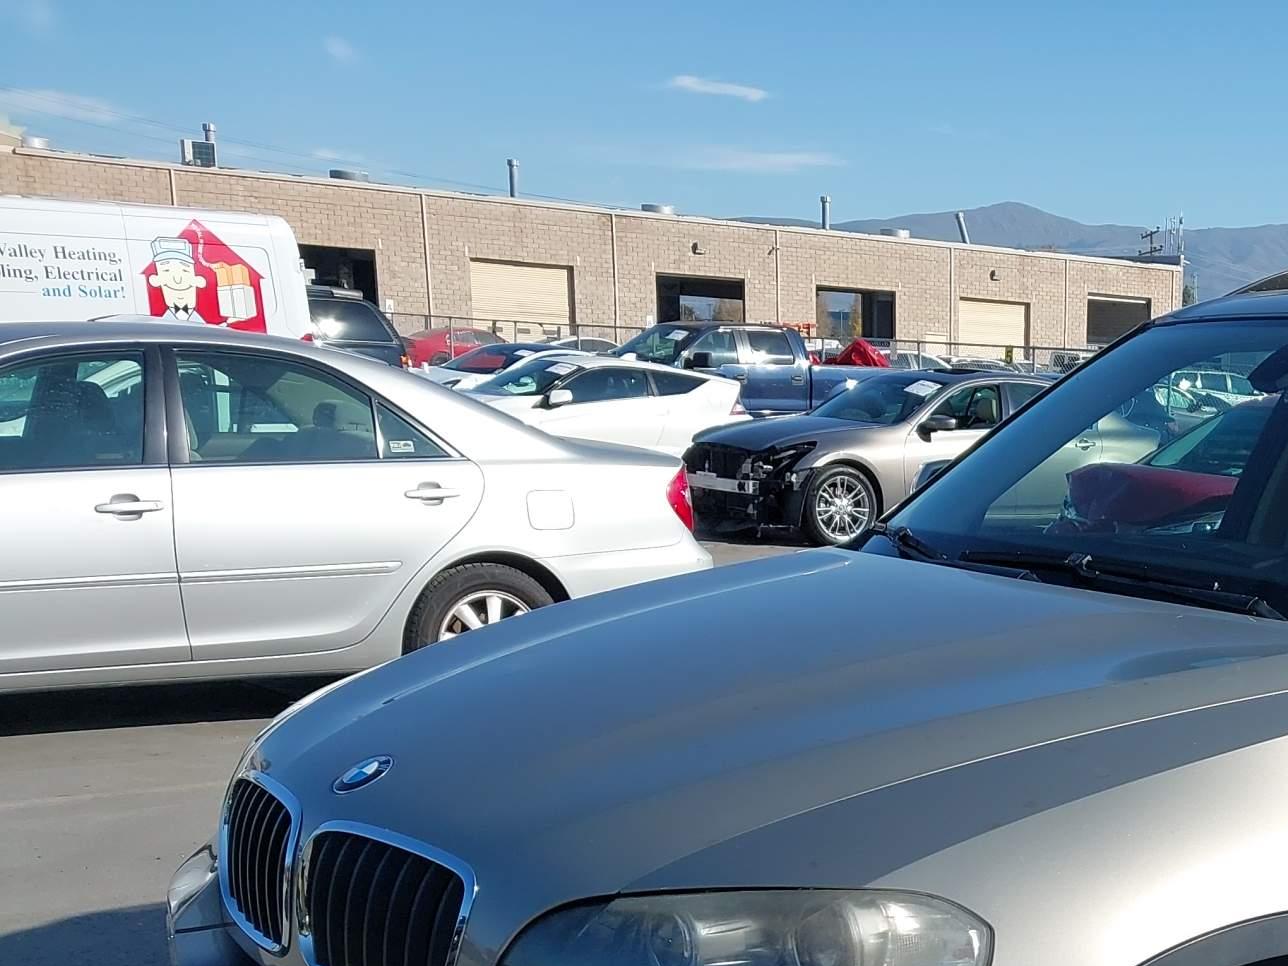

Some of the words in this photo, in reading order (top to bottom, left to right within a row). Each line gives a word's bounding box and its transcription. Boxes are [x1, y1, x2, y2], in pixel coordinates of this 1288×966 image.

[53, 246, 122, 264] Heating,
[0, 264, 38, 282] ling,
[44, 265, 123, 281] Electrical
[42, 285, 72, 297] and
[79, 285, 126, 298] Solar!
